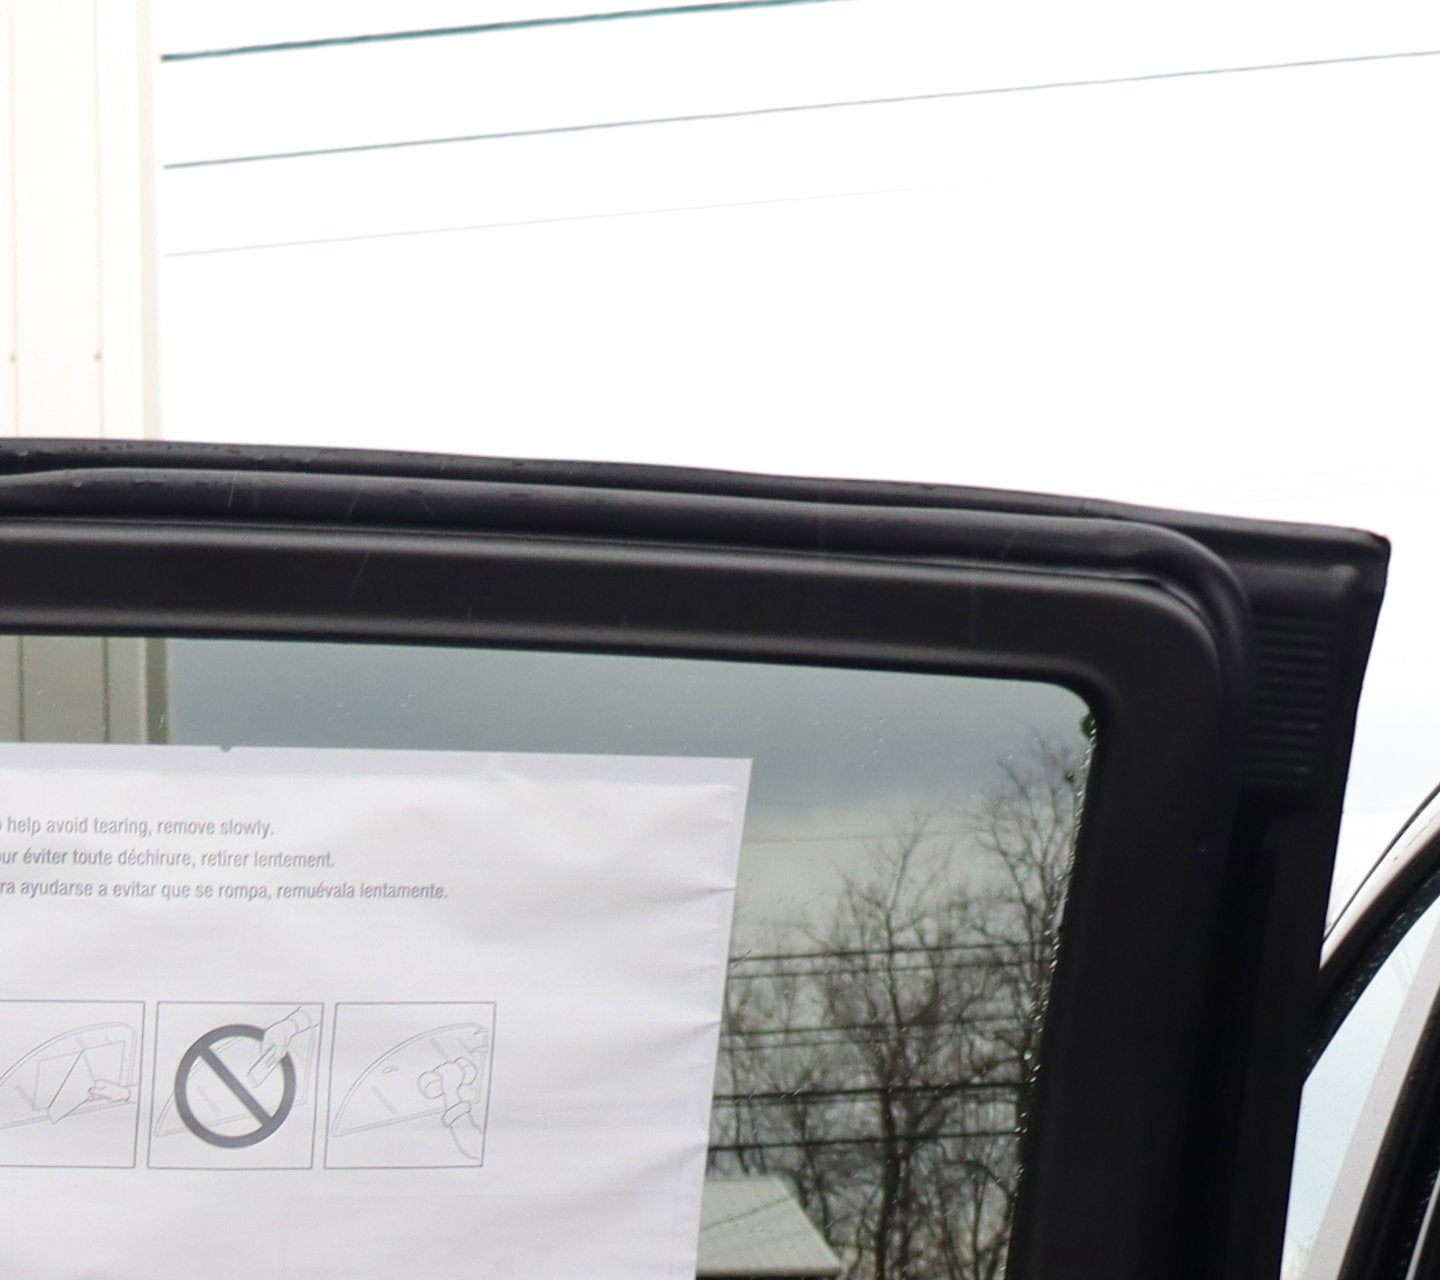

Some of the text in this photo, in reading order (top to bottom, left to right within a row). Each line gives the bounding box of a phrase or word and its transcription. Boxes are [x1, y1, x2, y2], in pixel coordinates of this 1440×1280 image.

[7, 815, 41, 837] help
[46, 816, 89, 834] avoid
[93, 817, 152, 839] tearing,
[157, 820, 216, 836] remove
[220, 818, 275, 840] slowly.
[22, 846, 68, 865] éviter
[72, 848, 113, 866] toute
[117, 847, 196, 869] déchirure,
[201, 850, 250, 868] retirer
[254, 850, 336, 869] lentement.
[20, 878, 94, 900] ayudarse
[97, 883, 109, 898] a
[112, 880, 157, 898] evitar
[161, 884, 191, 902] que
[195, 884, 214, 899] se
[217, 884, 272, 903] rompa,
[276, 880, 356, 899] remuévala
[360, 881, 449, 900] lentamente.
